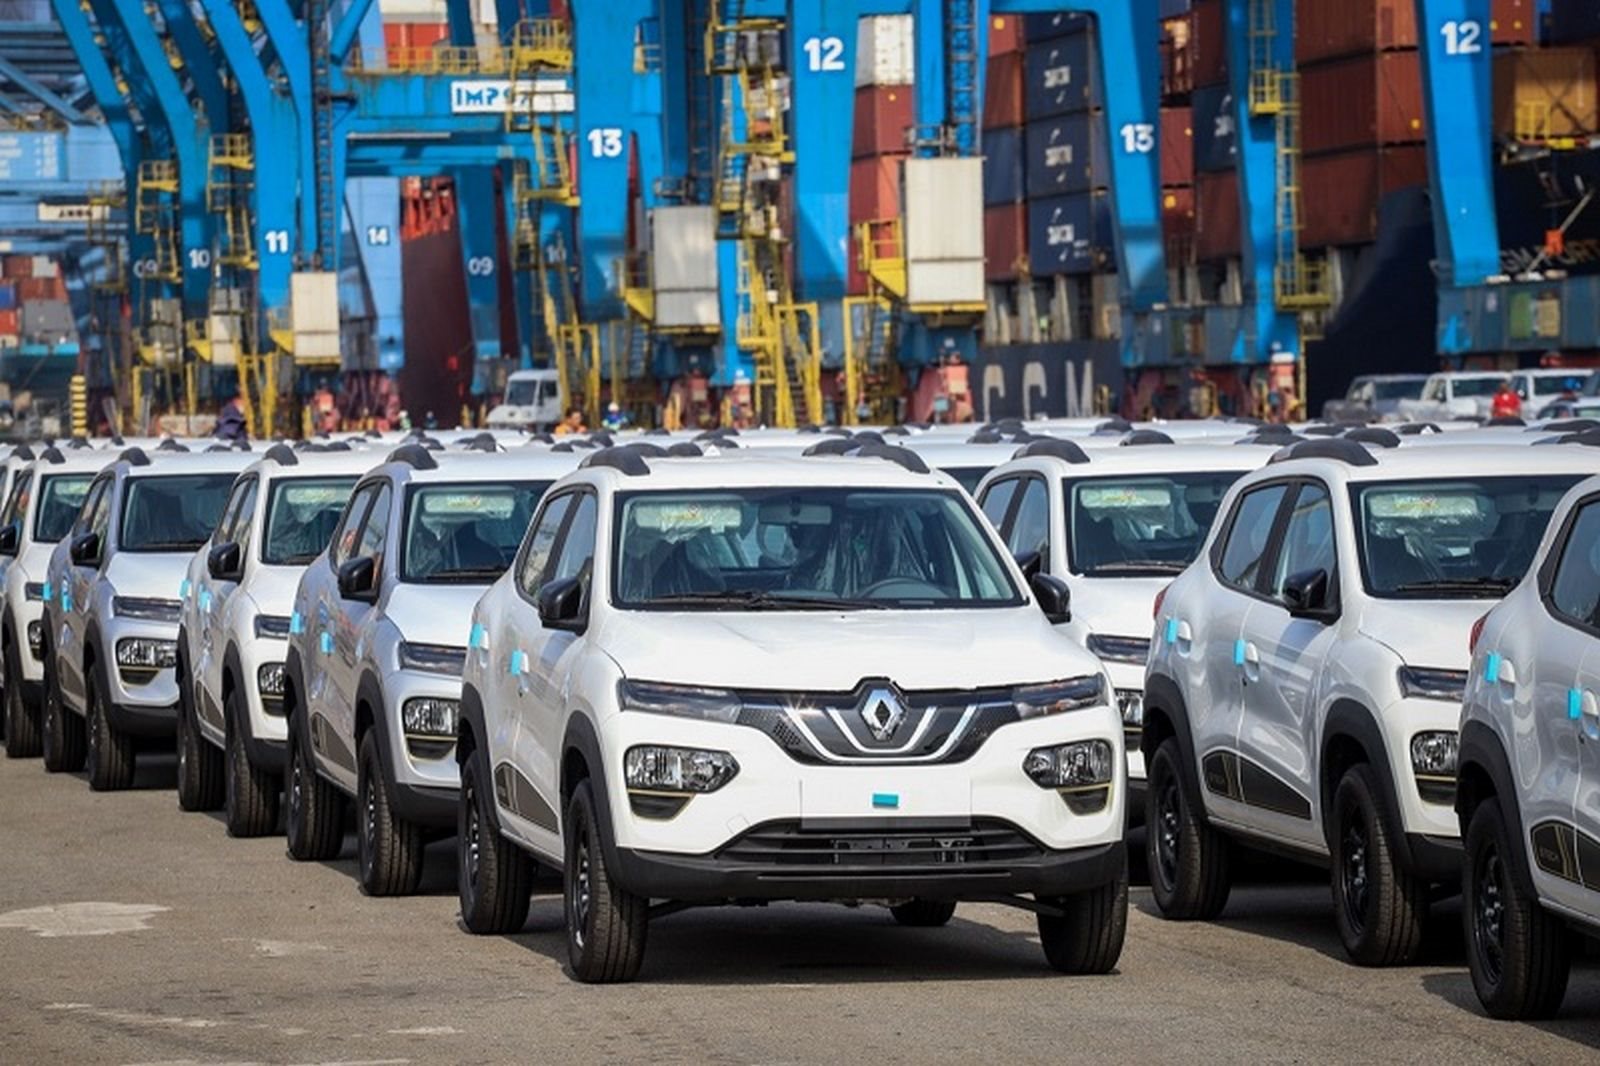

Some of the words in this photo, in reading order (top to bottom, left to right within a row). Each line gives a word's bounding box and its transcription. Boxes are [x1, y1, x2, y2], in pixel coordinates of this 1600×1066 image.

[1440, 21, 1481, 54] 12
[803, 37, 845, 71] 12
[587, 128, 622, 157] 13
[1120, 124, 1154, 152] 13
[265, 230, 289, 253] 11
[367, 227, 389, 245] 14
[188, 248, 210, 269] 10
[468, 256, 494, 276] 09
